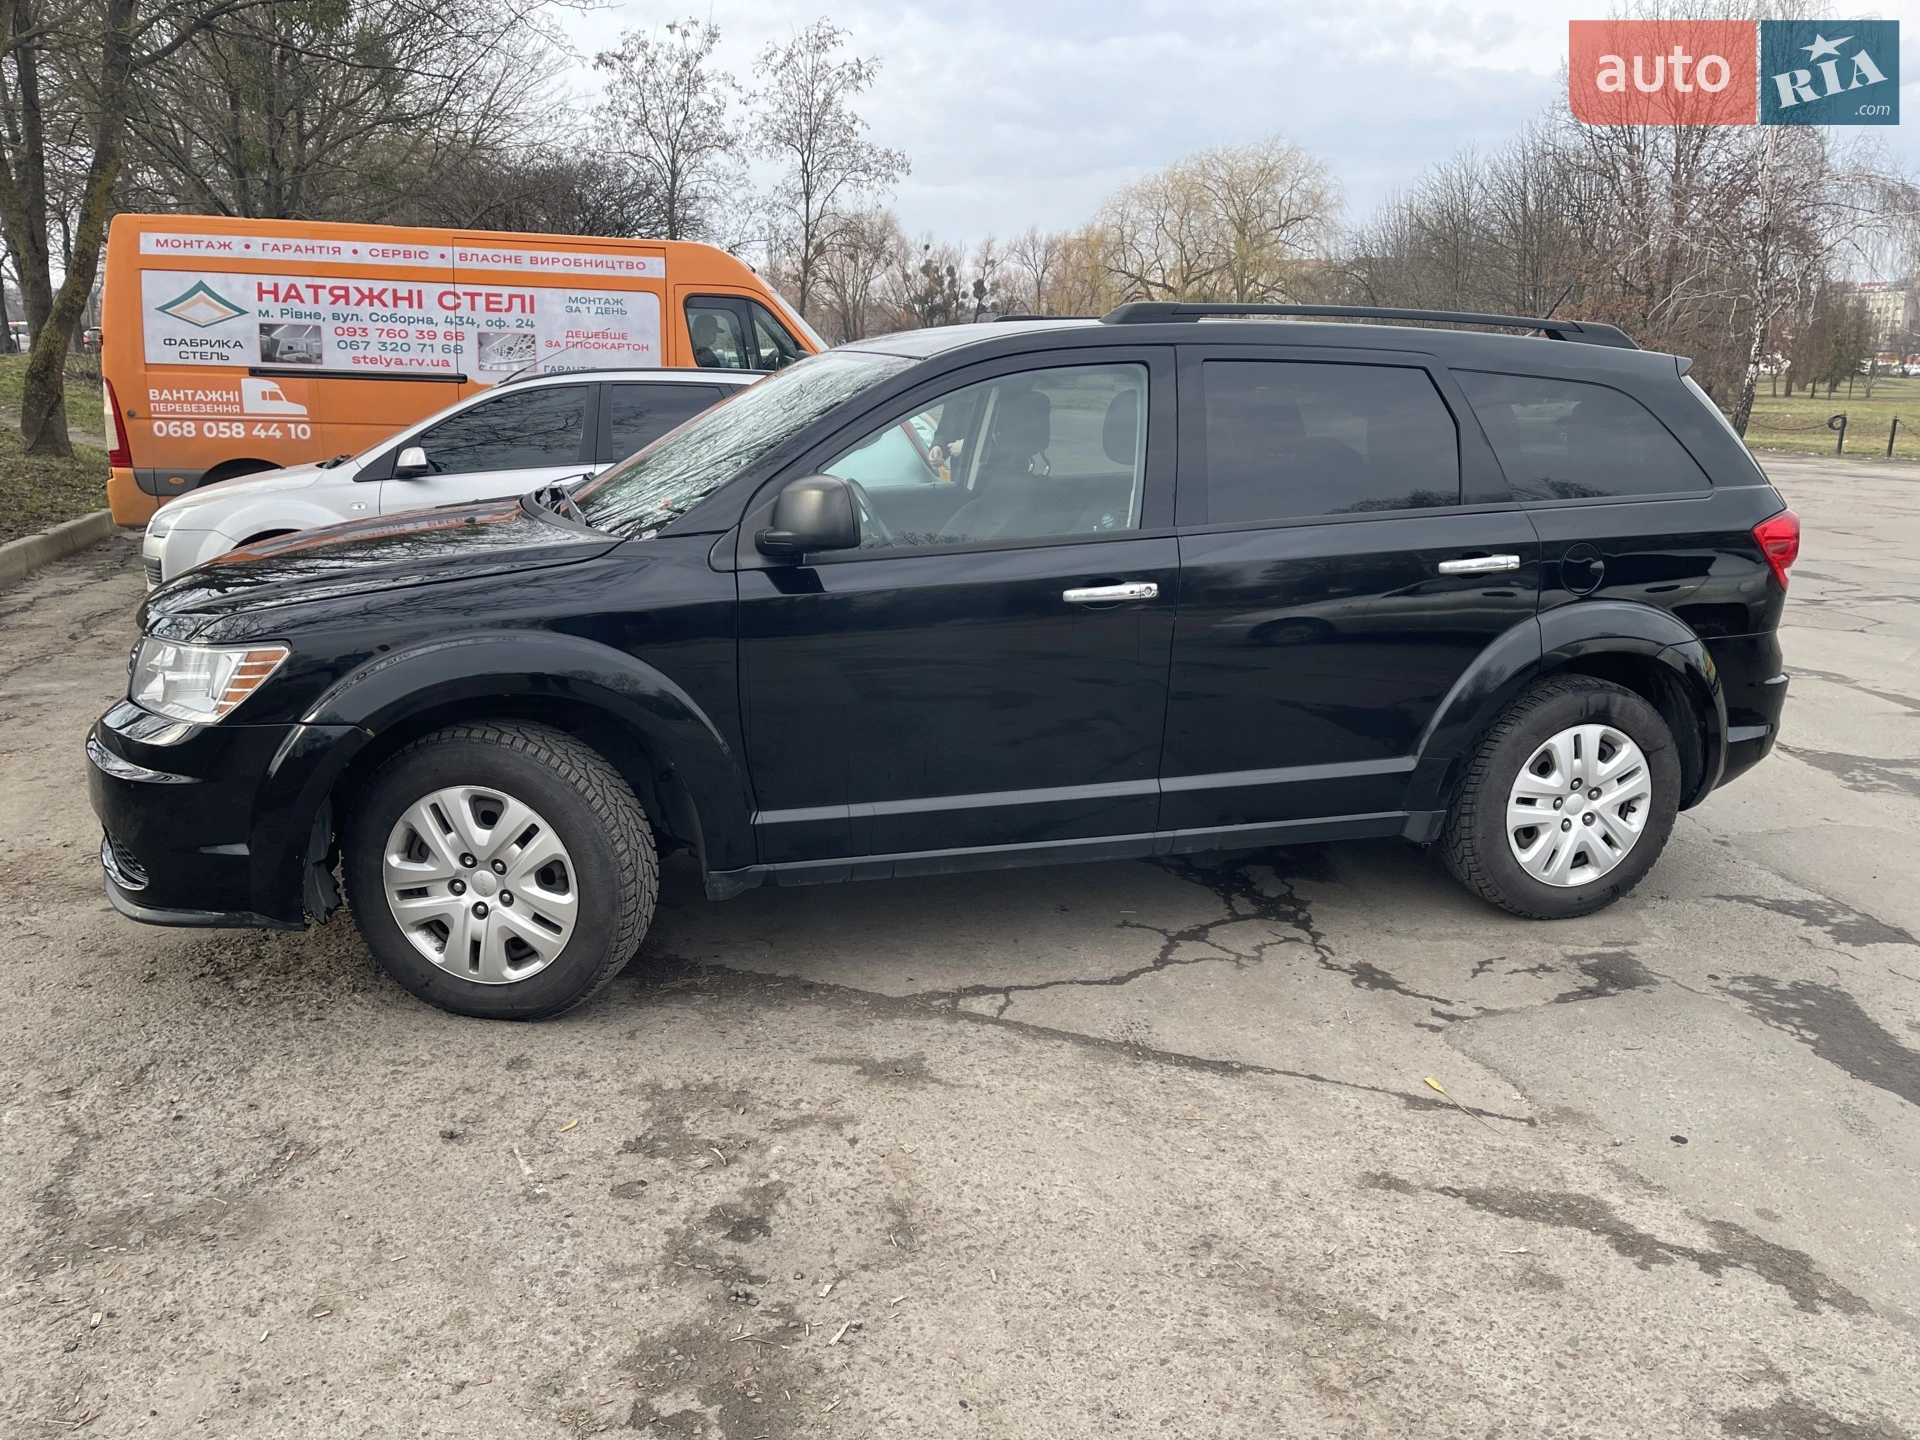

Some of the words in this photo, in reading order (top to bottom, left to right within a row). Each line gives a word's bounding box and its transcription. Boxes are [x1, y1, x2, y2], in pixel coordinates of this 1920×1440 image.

[155, 238, 233, 251] МОНТАЖ
[261, 242, 342, 255] ГАРАНТІЯ
[369, 248, 429, 260] СЕРВІС
[459, 252, 523, 265] ВЛАСНЕ
[529, 255, 646, 270] ВИРОБНИЦТВО
[256, 281, 423, 309] НАТЯЖНІ
[437, 290, 535, 314] СТЕЛІ
[568, 296, 624, 306] МОНТАЖ
[565, 305, 582, 314] ЗА
[585, 306, 591, 314] 1
[595, 306, 628, 316] ДЕНЬ
[258, 309, 274, 318] м.
[280, 308, 326, 322] Рівне,
[331, 312, 363, 323] вул.
[369, 312, 438, 327] Соборна,
[444, 315, 480, 328] 434,
[485, 317, 510, 329] оф.
[515, 318, 535, 329] 24
[334, 326, 368, 338] 093
[375, 328, 409, 339] 760
[415, 330, 437, 340] 39
[443, 331, 465, 341] 66
[565, 330, 628, 340] ДЕШЕВШЕ
[163, 338, 244, 349] ФАБРИКА
[337, 340, 370, 351] 067
[378, 341, 411, 353] 320
[417, 343, 435, 353] 71
[441, 344, 464, 354] 68
[544, 340, 561, 348] ЗА
[565, 341, 649, 351] ГІПСОКАРТОН
[178, 350, 230, 361] СТЕЛЬ
[352, 355, 451, 367] stelya.rv.ua
[149, 389, 239, 402] ВАНТАЖНІ
[150, 403, 240, 413] ПЕРЕВЕЗЕННЯ
[153, 420, 197, 437] 068
[203, 421, 245, 438] 058
[252, 423, 282, 439] 44
[287, 423, 312, 440] 10
